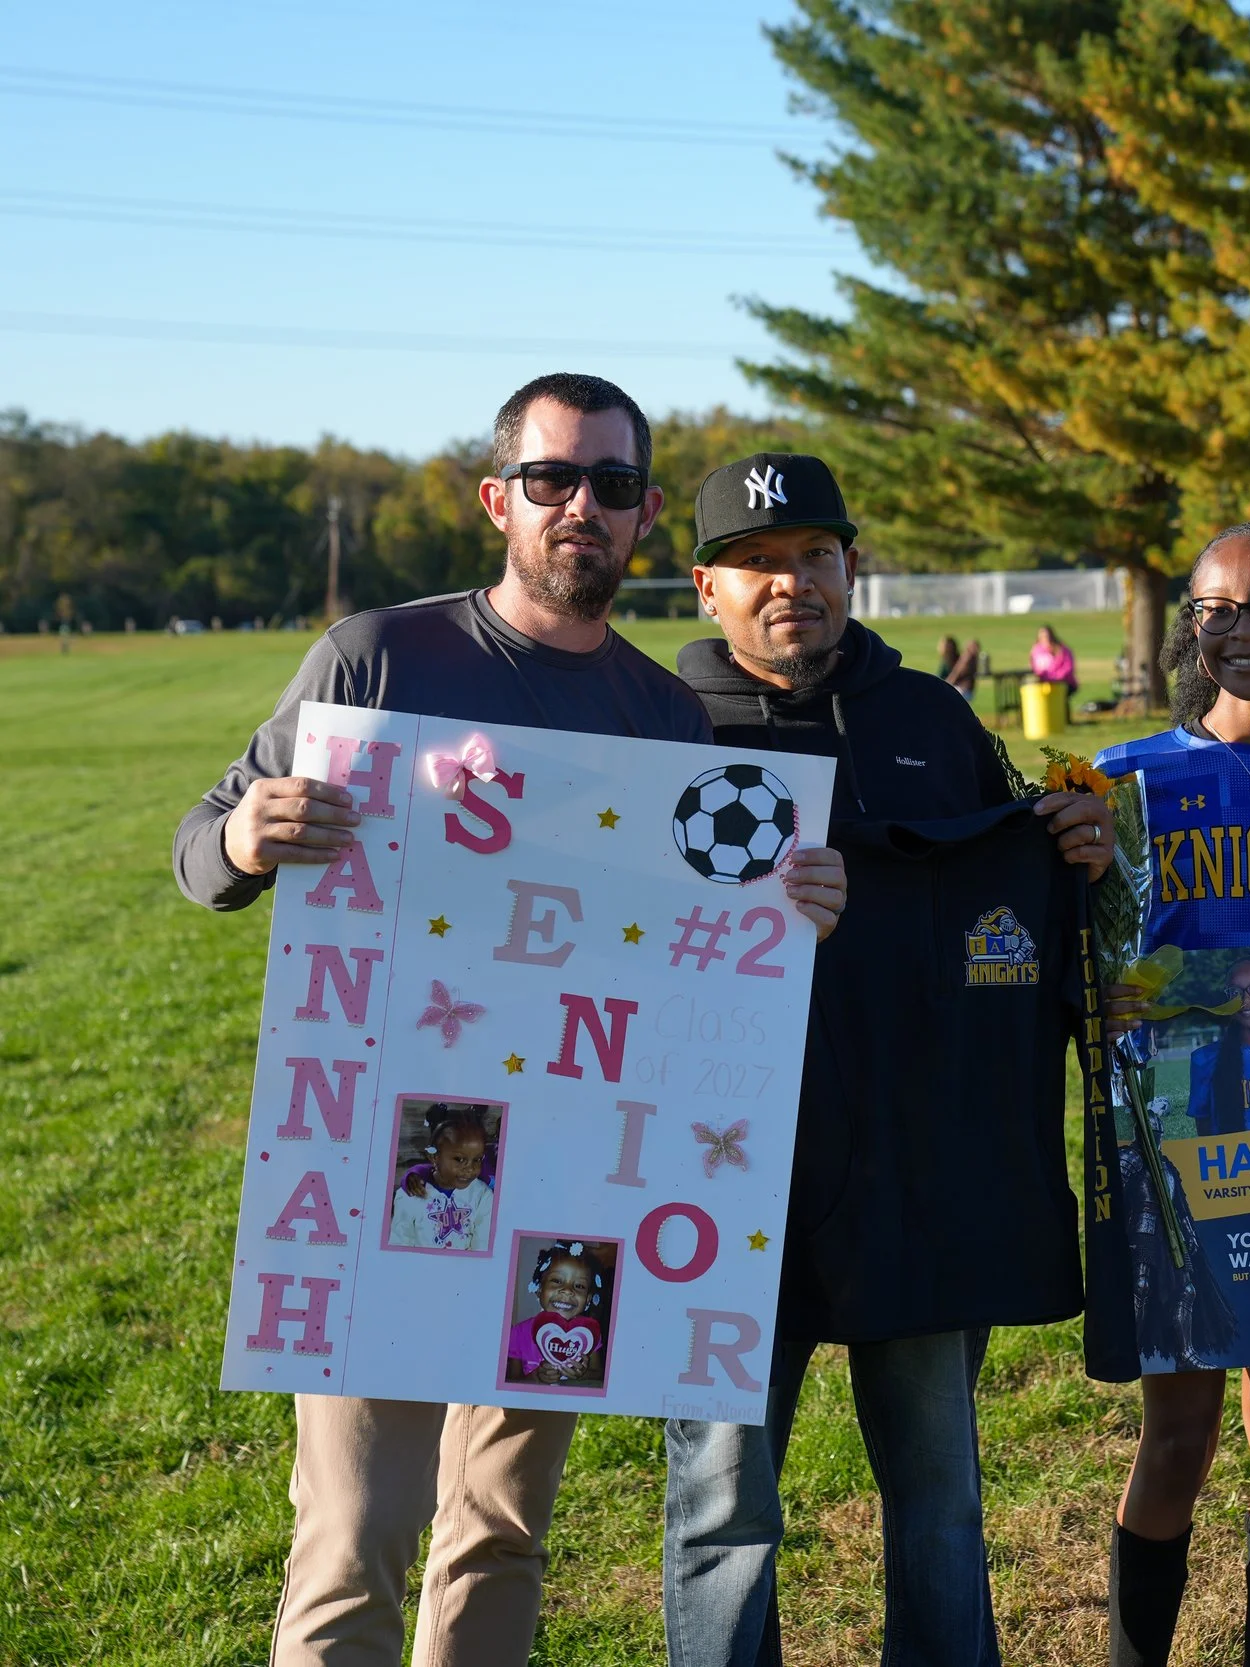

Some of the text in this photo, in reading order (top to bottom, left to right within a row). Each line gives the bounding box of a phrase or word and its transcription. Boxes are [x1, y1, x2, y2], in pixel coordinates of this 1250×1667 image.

[744, 464, 788, 509] NY
[895, 755, 926, 767] Hollister
[668, 905, 786, 979] #2
[968, 962, 1038, 984] KNIGHTS
[655, 994, 766, 1045] Class
[245, 735, 402, 1356] HANNAH
[444, 765, 762, 1392] SENIOR
[635, 1051, 775, 1100] of 2027
[1232, 1272, 1249, 1282] BUT
